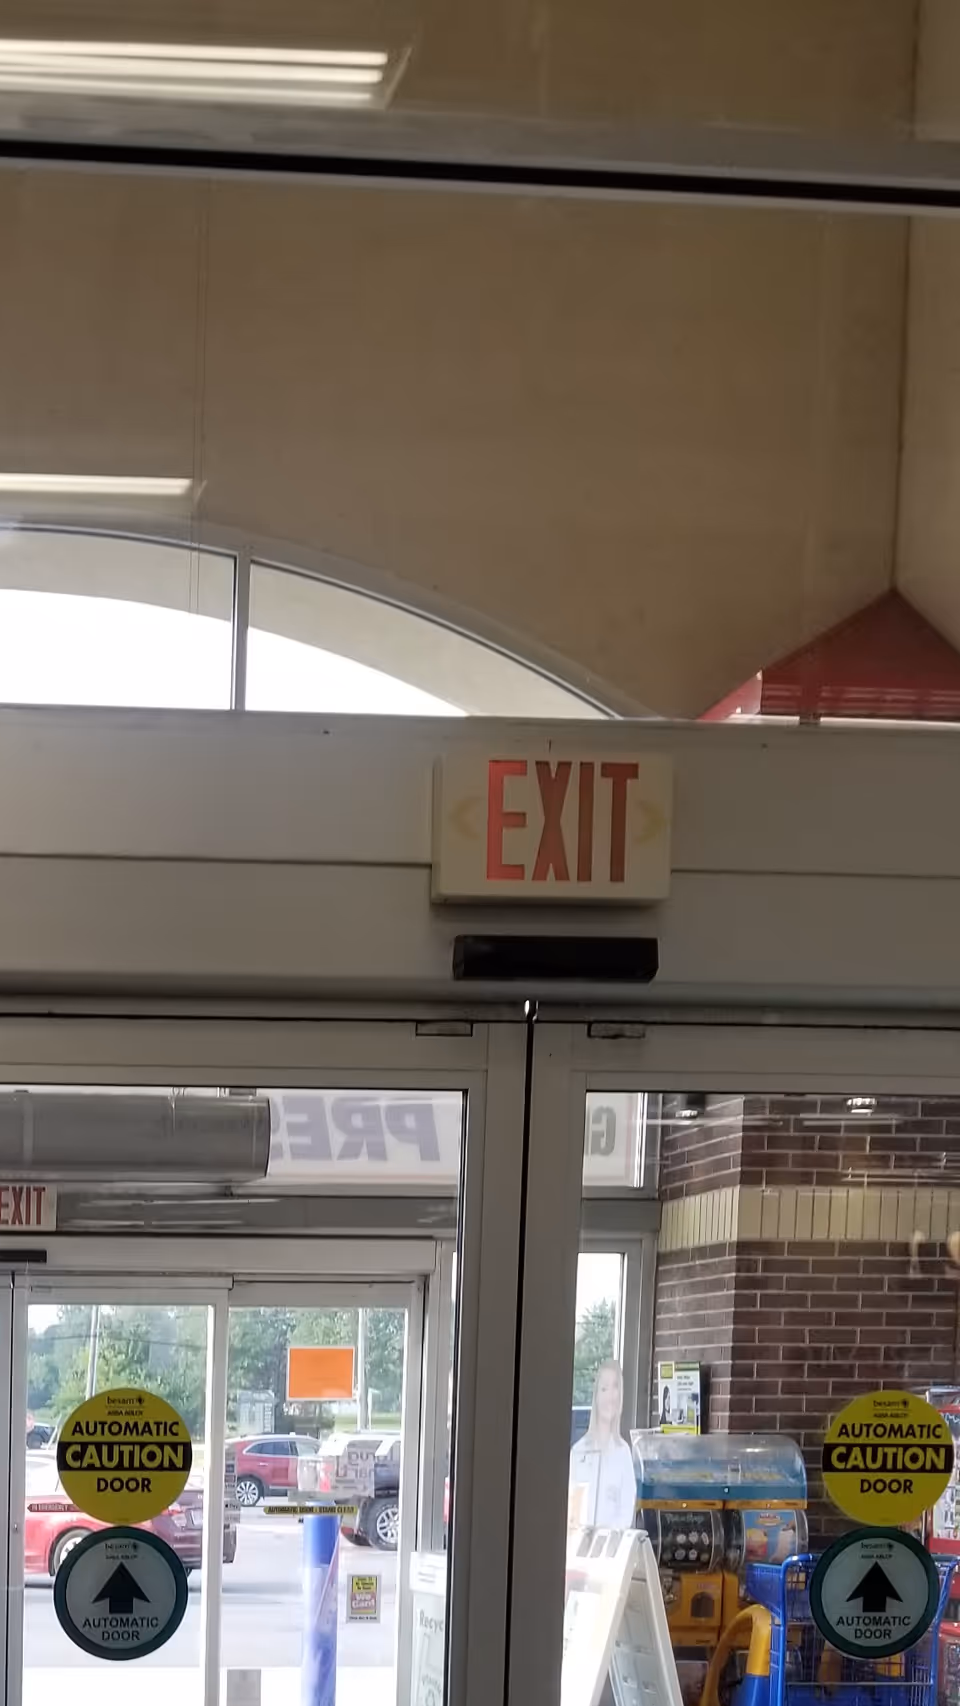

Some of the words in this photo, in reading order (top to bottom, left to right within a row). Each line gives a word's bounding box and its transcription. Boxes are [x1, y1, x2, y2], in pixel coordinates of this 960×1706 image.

[486, 759, 640, 883] EXIT
[71, 1420, 180, 1436] AUTOMATIC
[837, 1422, 943, 1439] AUTOMATIC
[65, 1443, 184, 1469] CAUTION
[830, 1445, 946, 1470] CAUTION
[96, 1477, 152, 1493] DOOR
[859, 1478, 913, 1494] DOOR
[82, 1616, 159, 1629] AUTOMATIC
[836, 1615, 912, 1627] AUTOMATIC
[101, 1630, 140, 1641] DOOR
[854, 1627, 892, 1639] DOOR
